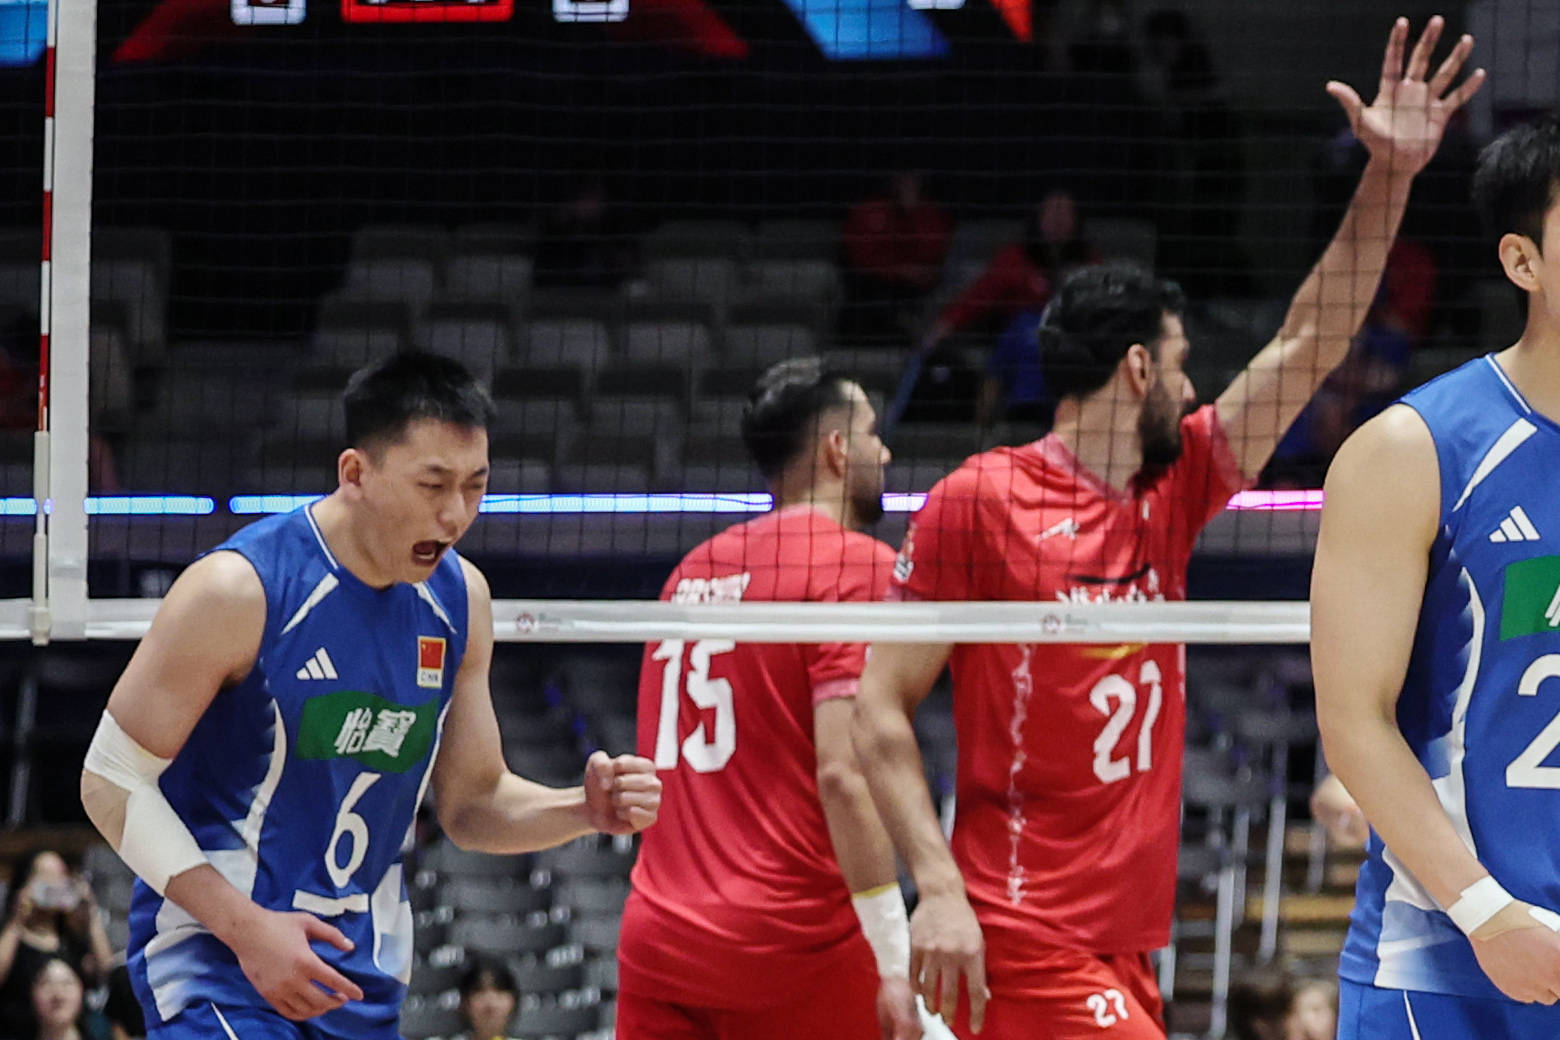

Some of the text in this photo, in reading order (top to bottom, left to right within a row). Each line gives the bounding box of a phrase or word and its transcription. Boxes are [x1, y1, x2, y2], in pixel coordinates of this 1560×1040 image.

[334, 706, 417, 758] 怡寶
[652, 638, 737, 773] 15
[324, 771, 382, 888] 6
